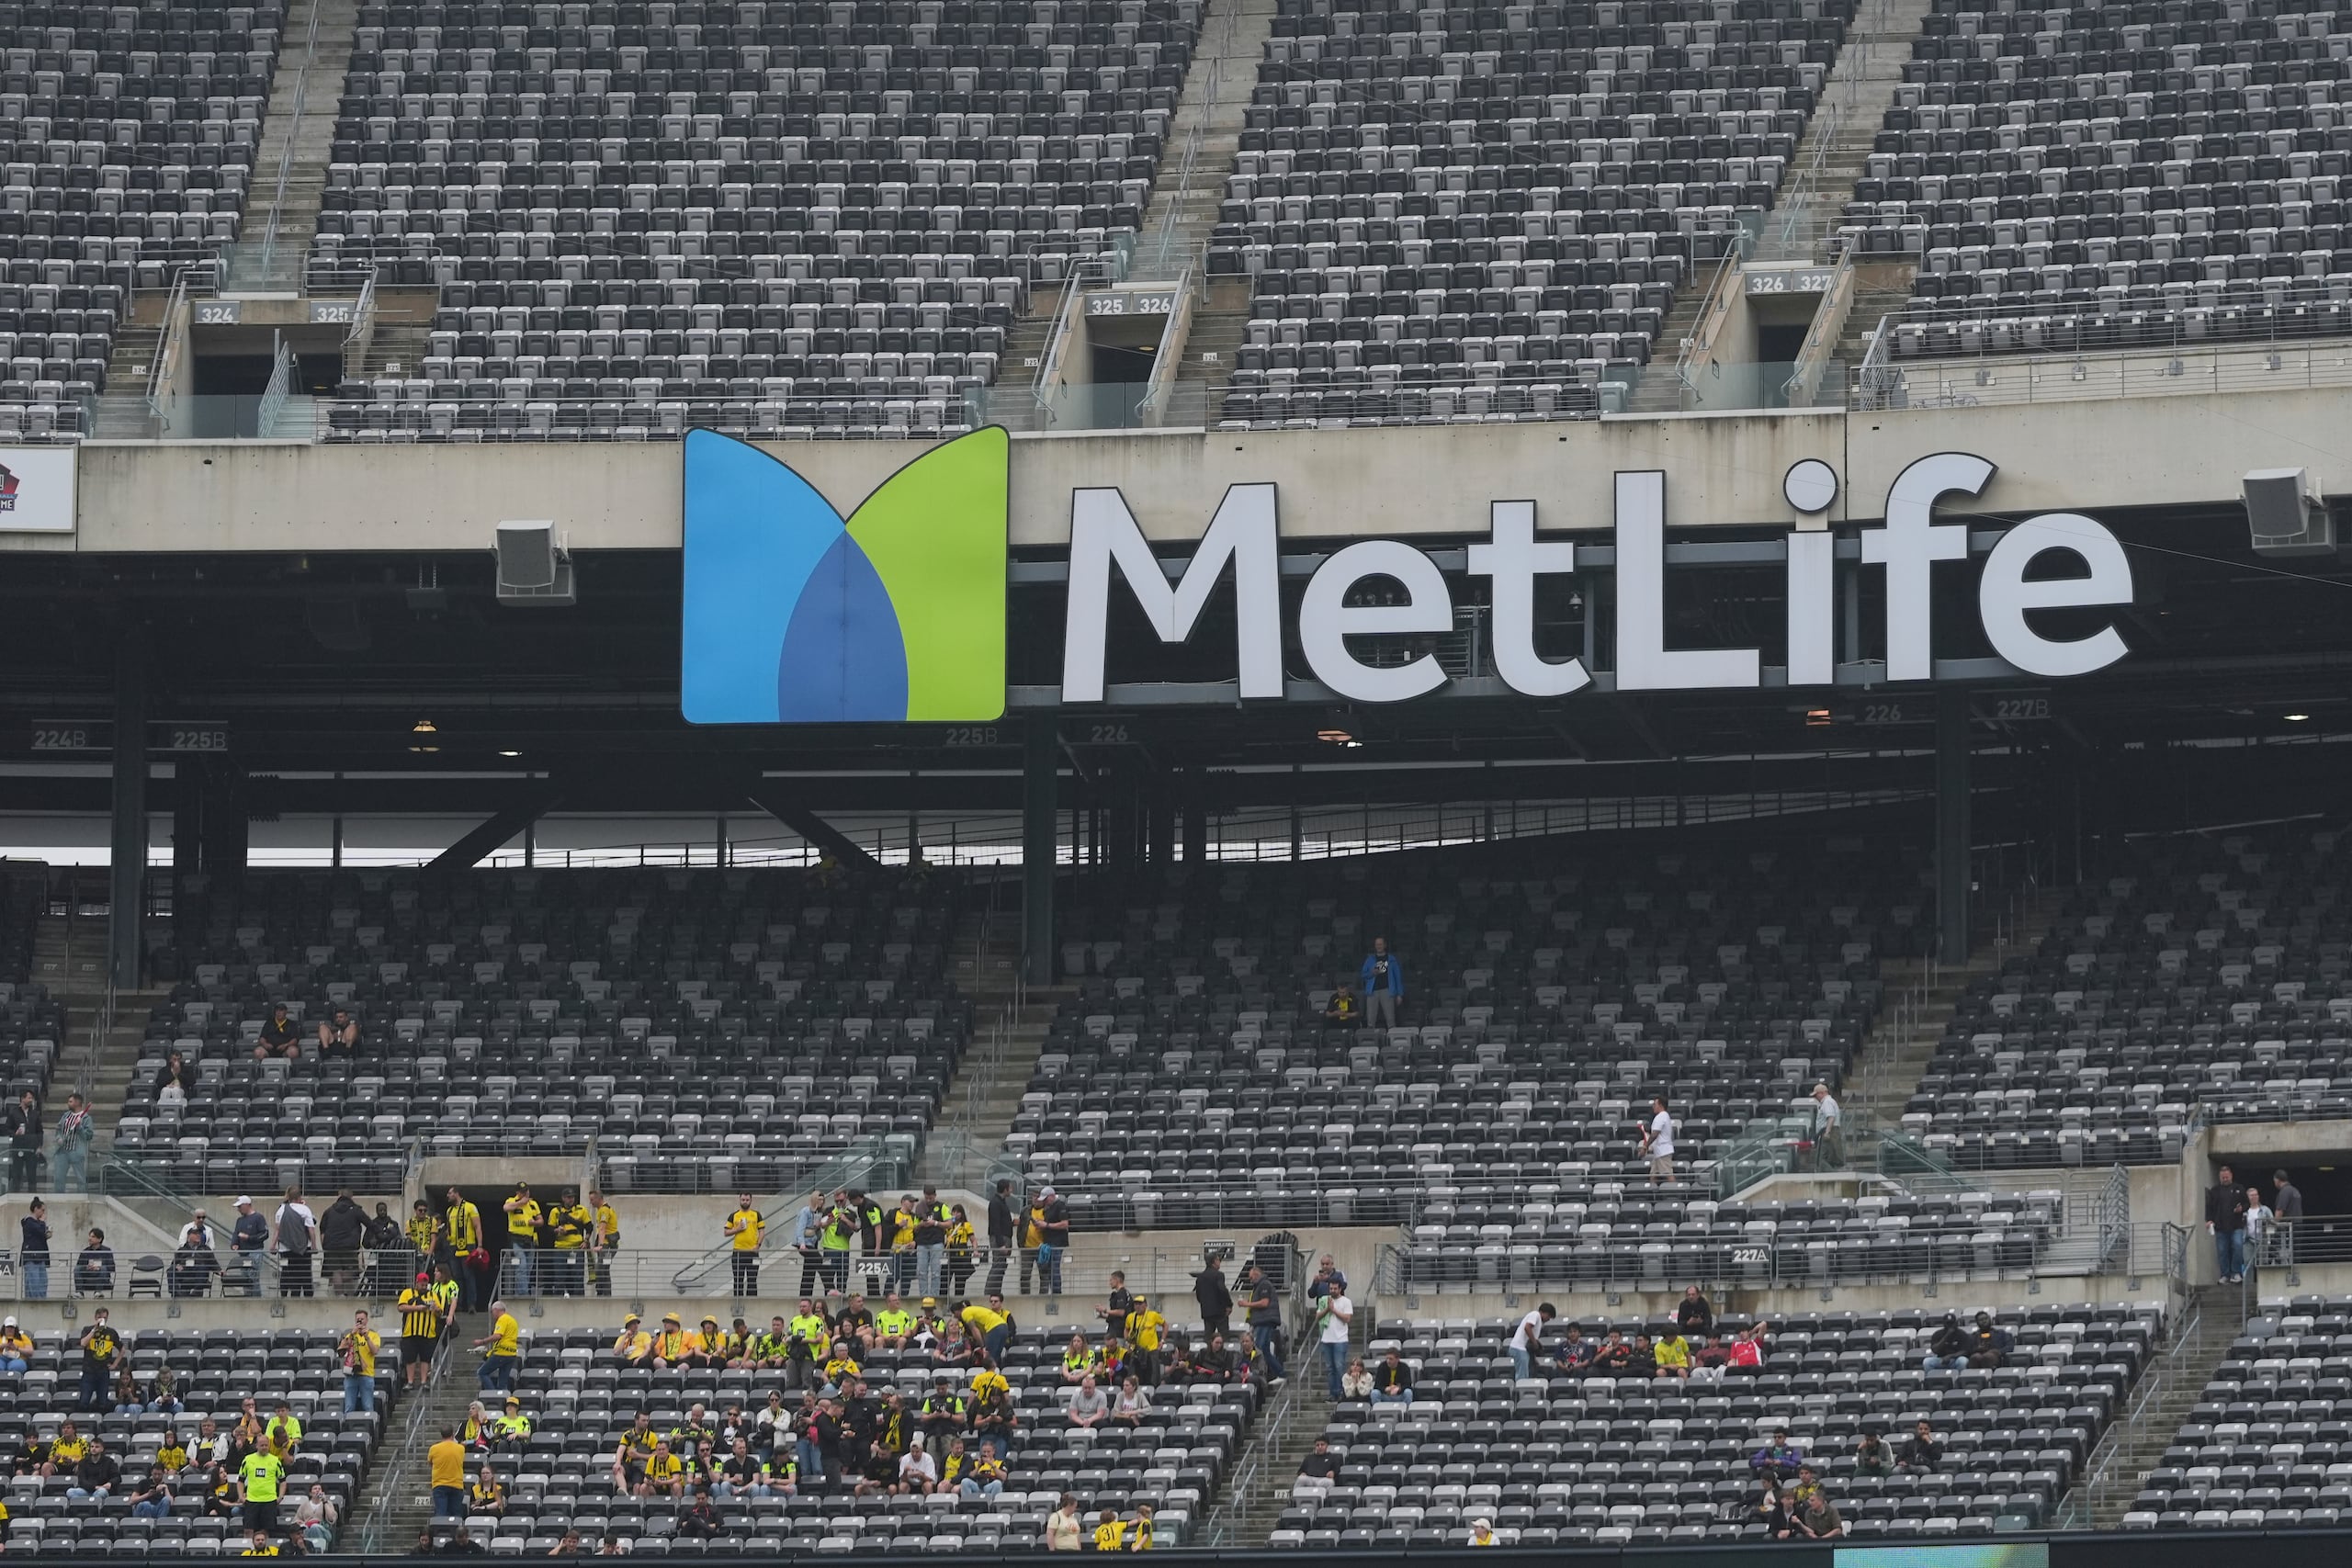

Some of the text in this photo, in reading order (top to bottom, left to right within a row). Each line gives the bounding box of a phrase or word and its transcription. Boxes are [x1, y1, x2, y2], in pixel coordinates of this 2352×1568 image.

[1752, 276, 1784, 292] 326
[1800, 276, 1832, 290] 327
[1091, 299, 1124, 314] 325
[1139, 298, 1171, 312] 326
[201, 307, 233, 322] 324
[317, 307, 348, 322] 325
[1061, 451, 2134, 704] MetLife
[1865, 705, 1901, 722] 226
[1997, 699, 2048, 718] 227B
[34, 730, 86, 748] 224B
[174, 731, 226, 749] 225B
[946, 728, 998, 745] 225B
[1091, 726, 1128, 742] 226
[1734, 1249, 1767, 1260] 227A
[858, 1262, 891, 1275] 225A
[1102, 1526, 1114, 1541] 31
